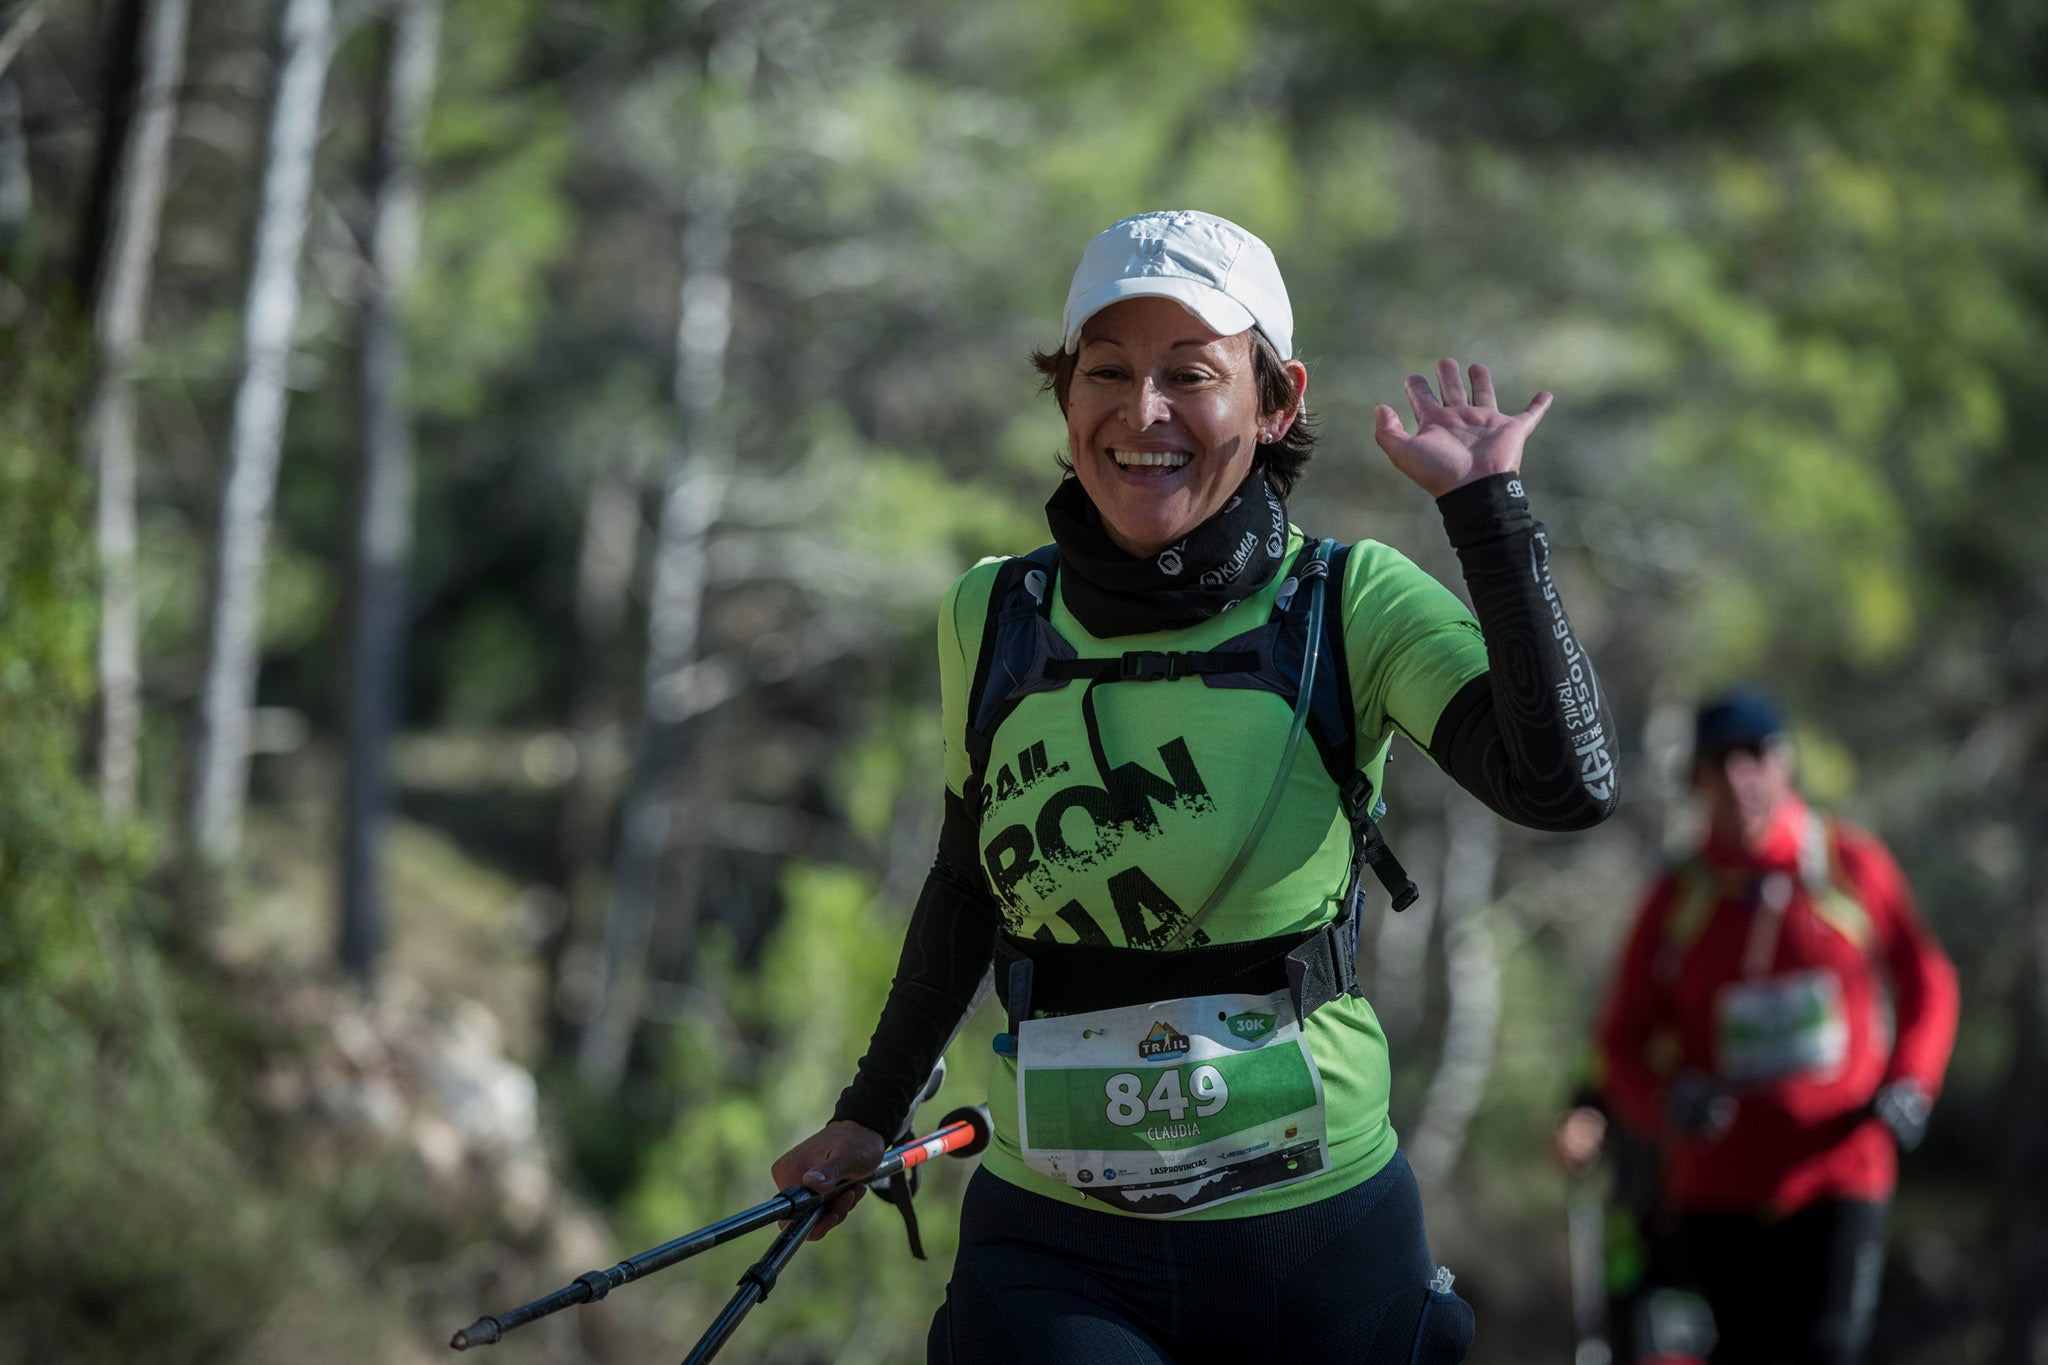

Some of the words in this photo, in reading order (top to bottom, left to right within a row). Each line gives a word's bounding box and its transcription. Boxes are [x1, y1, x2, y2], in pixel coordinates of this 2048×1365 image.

[1221, 530, 1258, 580] KLIMIA
[1555, 678, 1584, 731] TRAILS
[1236, 1018, 1266, 1033] 30K
[1104, 1064, 1230, 1127] 849
[1146, 1120, 1202, 1141] CLAUDIA
[1149, 1158, 1208, 1176] LASPROVINCIAS
